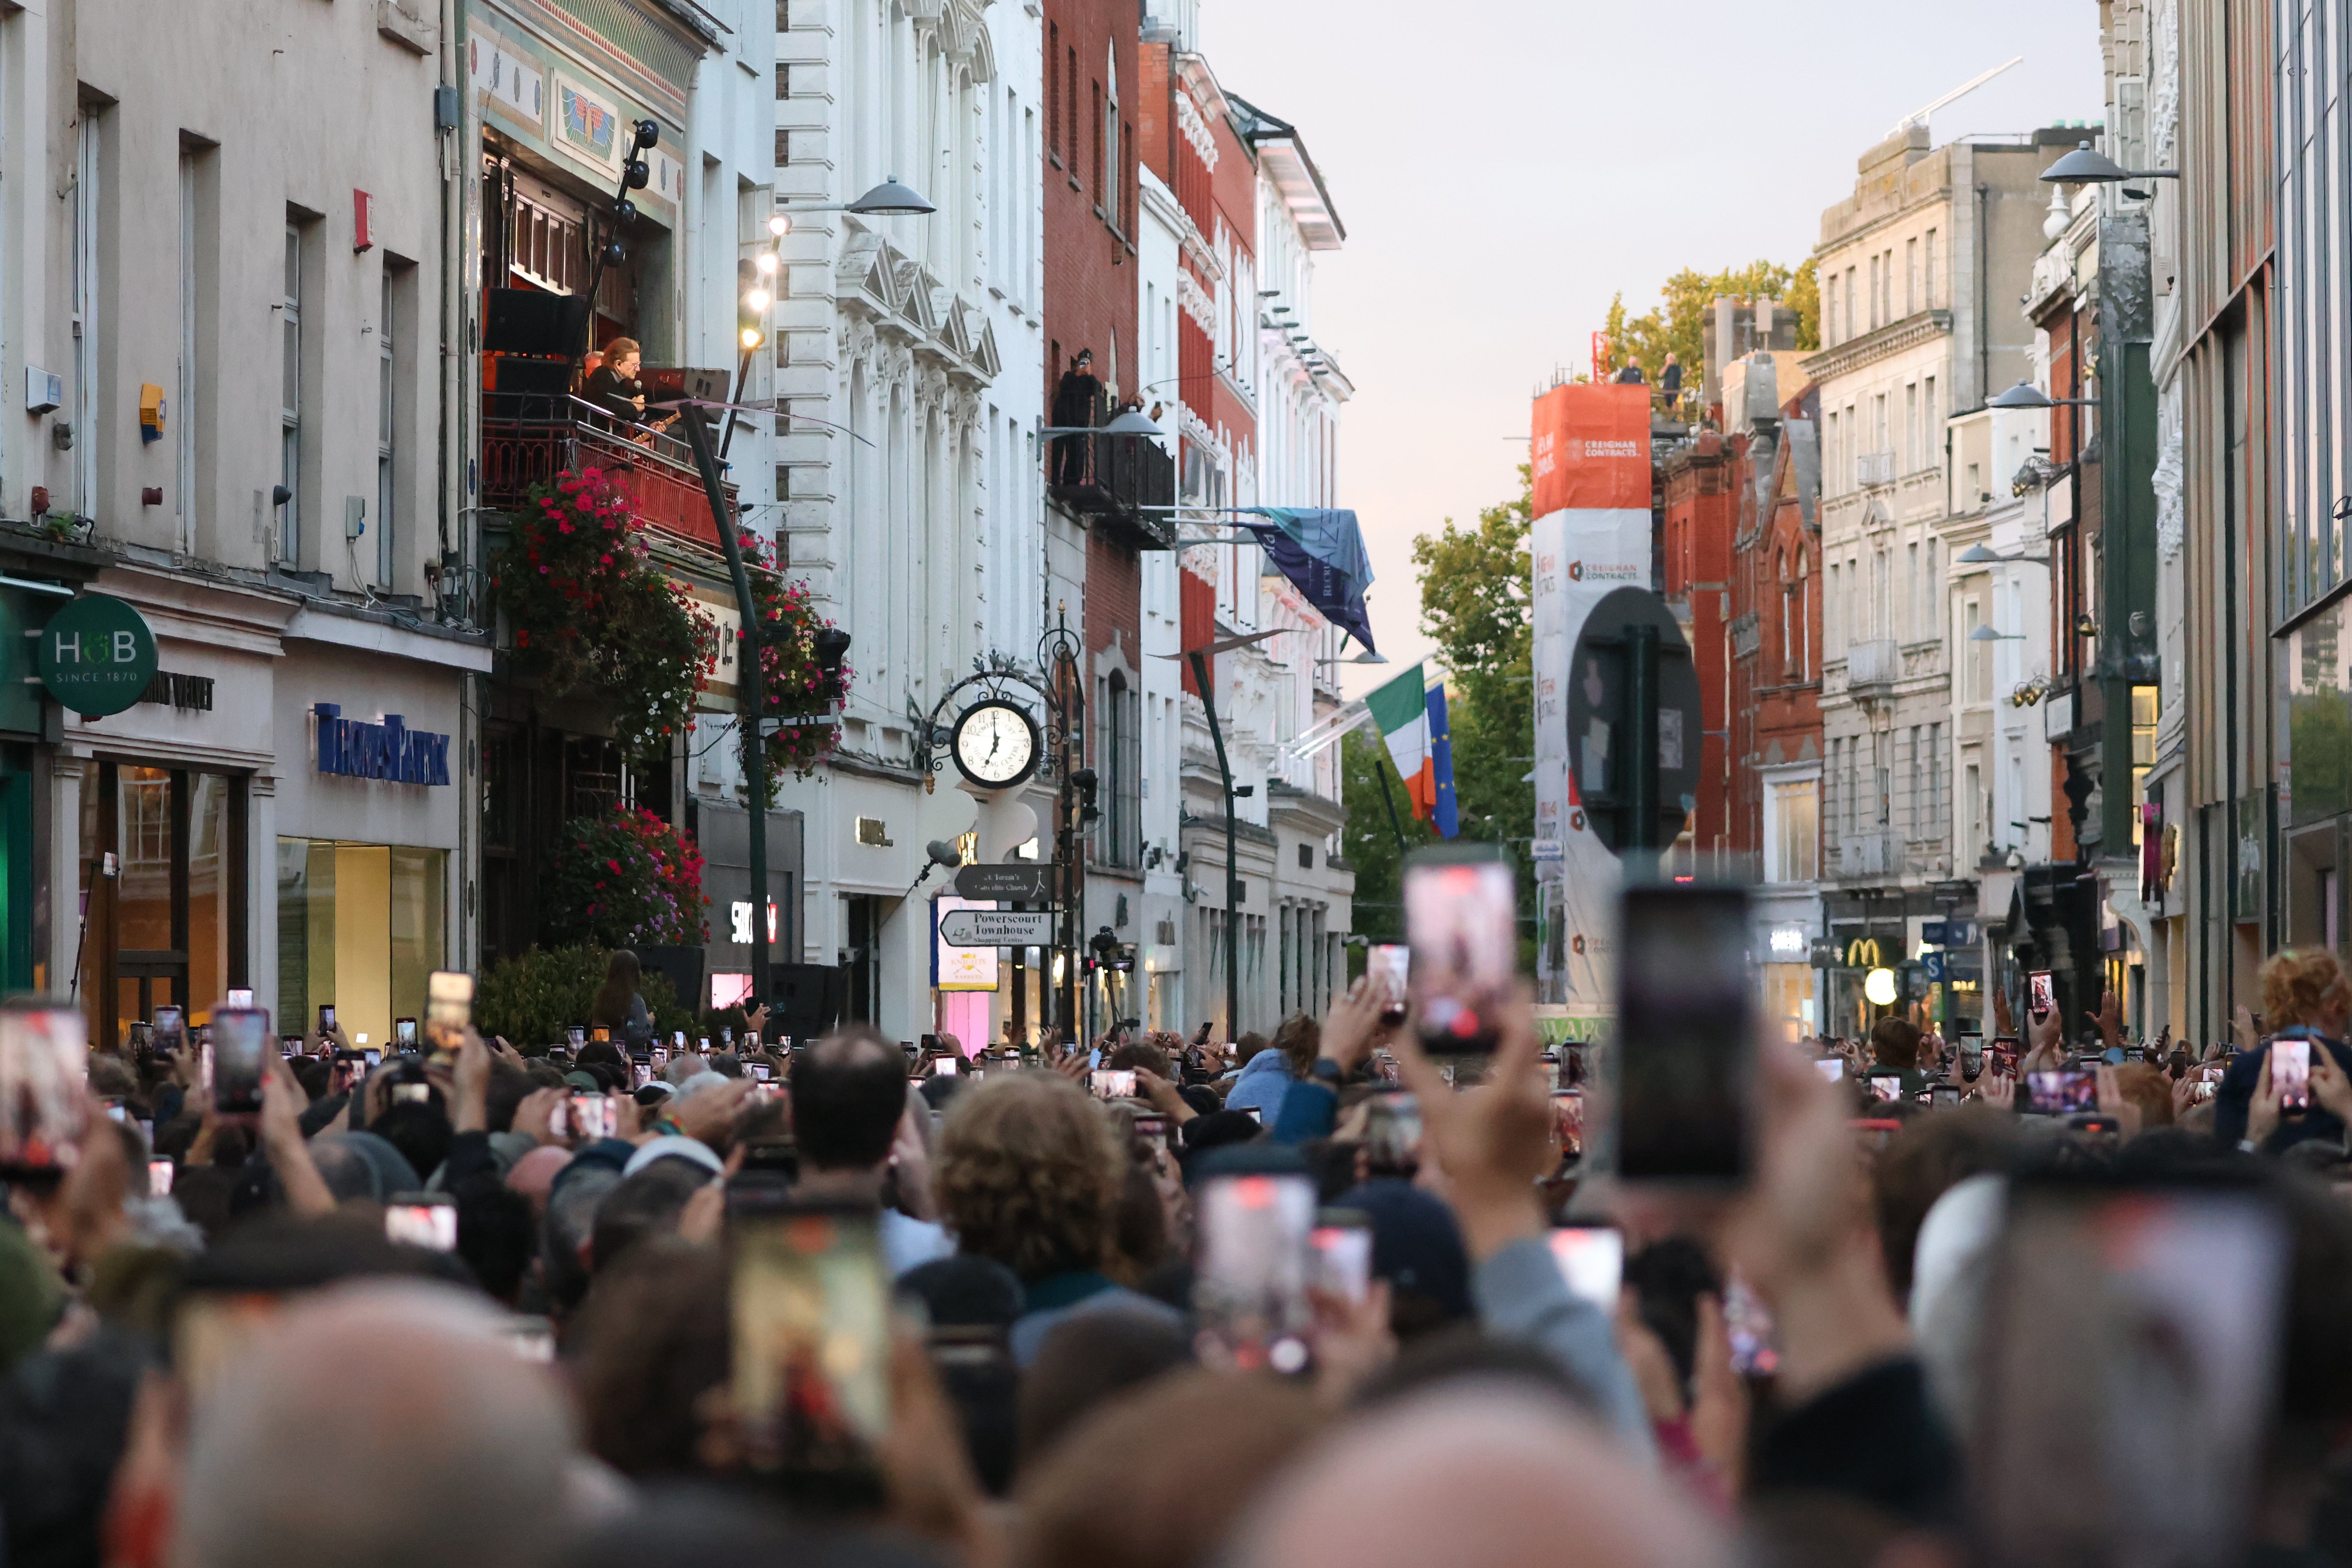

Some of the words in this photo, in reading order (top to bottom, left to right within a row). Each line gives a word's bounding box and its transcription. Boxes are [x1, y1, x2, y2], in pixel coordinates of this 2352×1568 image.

[1585, 440, 1637, 448] CREIGHAN
[56, 673, 99, 683] SINCE
[107, 672, 136, 681] 1870
[978, 714, 985, 723] 11
[991, 710, 999, 719] 12
[967, 724, 976, 734] 10
[1018, 723, 1024, 732] 2
[962, 740, 968, 749] 9
[1024, 738, 1030, 748] 3
[968, 756, 974, 766] 8
[1018, 755, 1024, 764] 4
[981, 766, 987, 775] 7
[994, 769, 999, 778] 6
[1008, 765, 1014, 774] 5
[974, 913, 1042, 923] Powerscourt
[974, 924, 1034, 935] Townhouse
